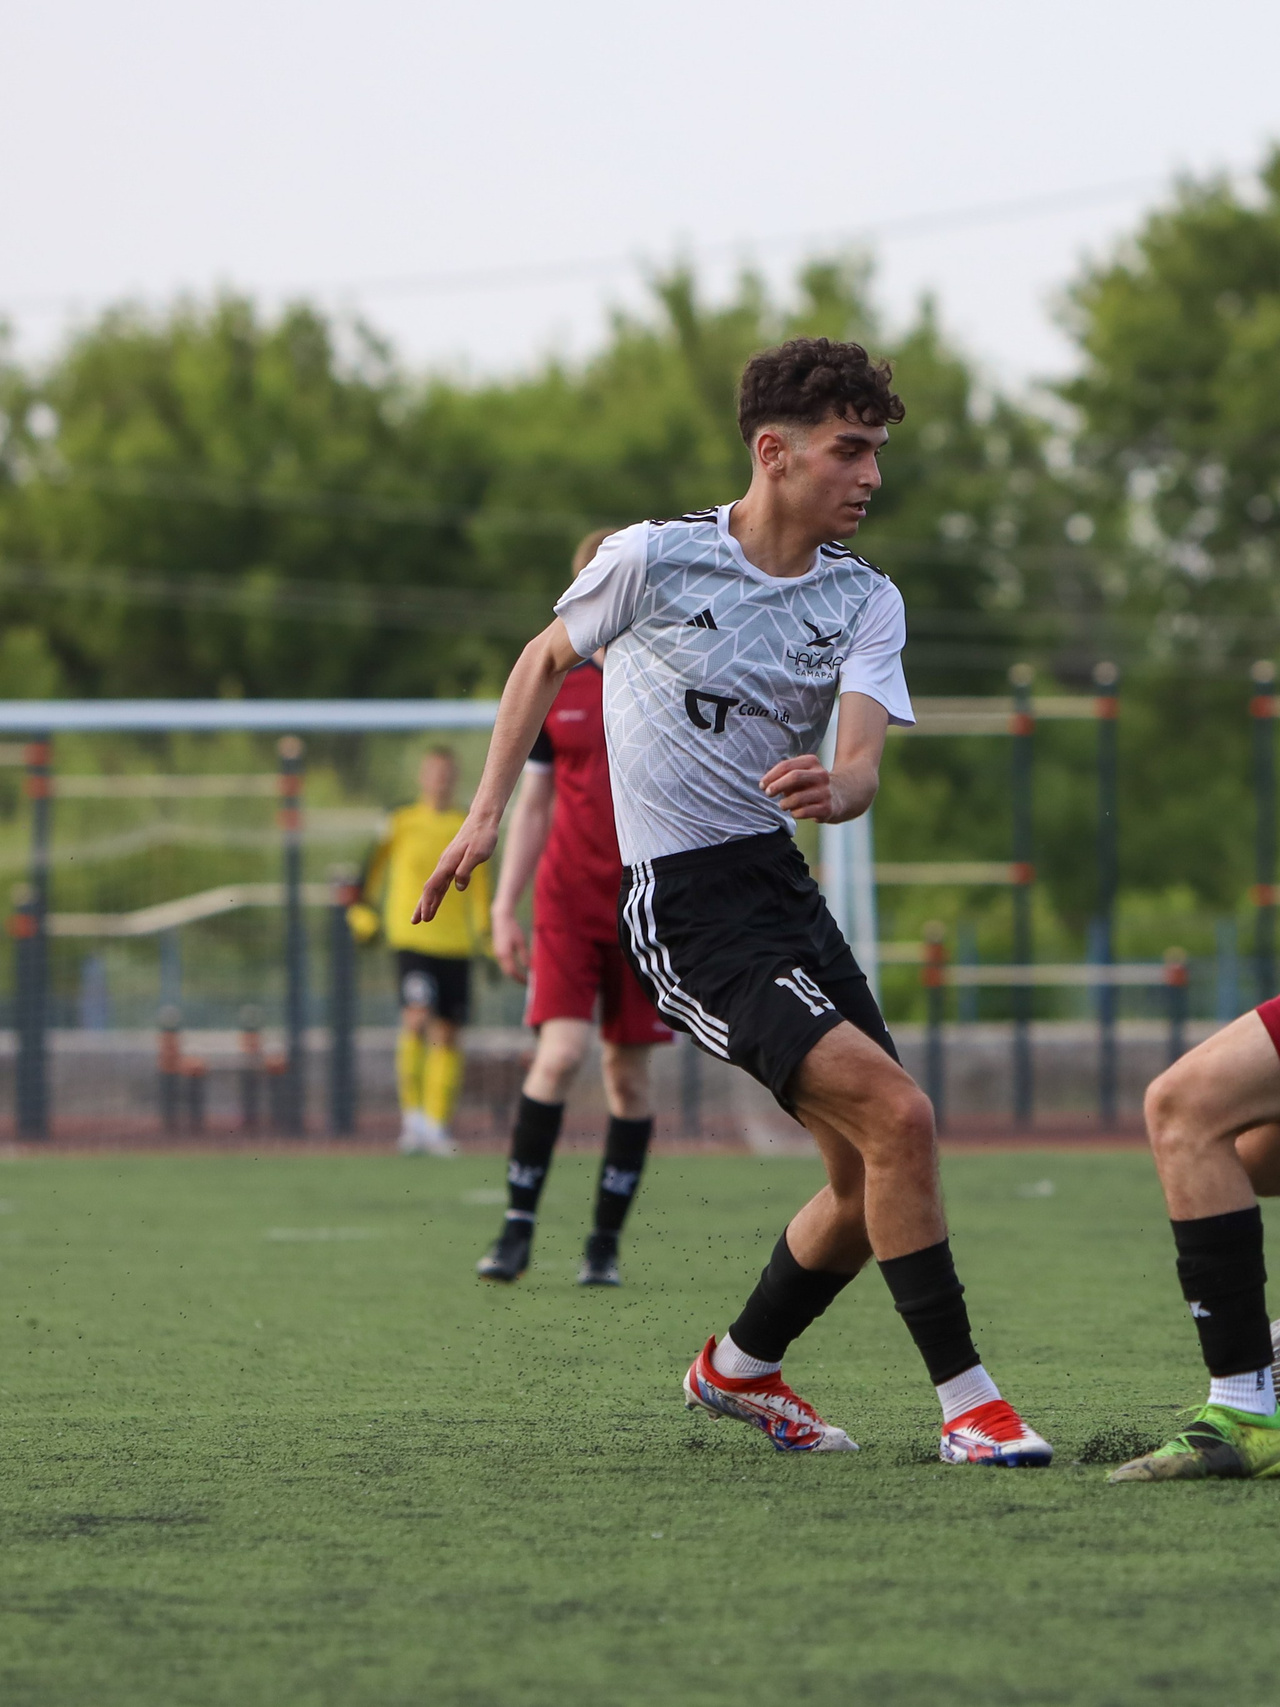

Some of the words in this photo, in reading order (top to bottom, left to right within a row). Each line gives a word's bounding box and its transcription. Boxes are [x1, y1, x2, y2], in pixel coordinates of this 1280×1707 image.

[795, 668, 834, 679] САМАРА
[738, 703, 770, 717] Coin
[773, 966, 838, 1018] 19
